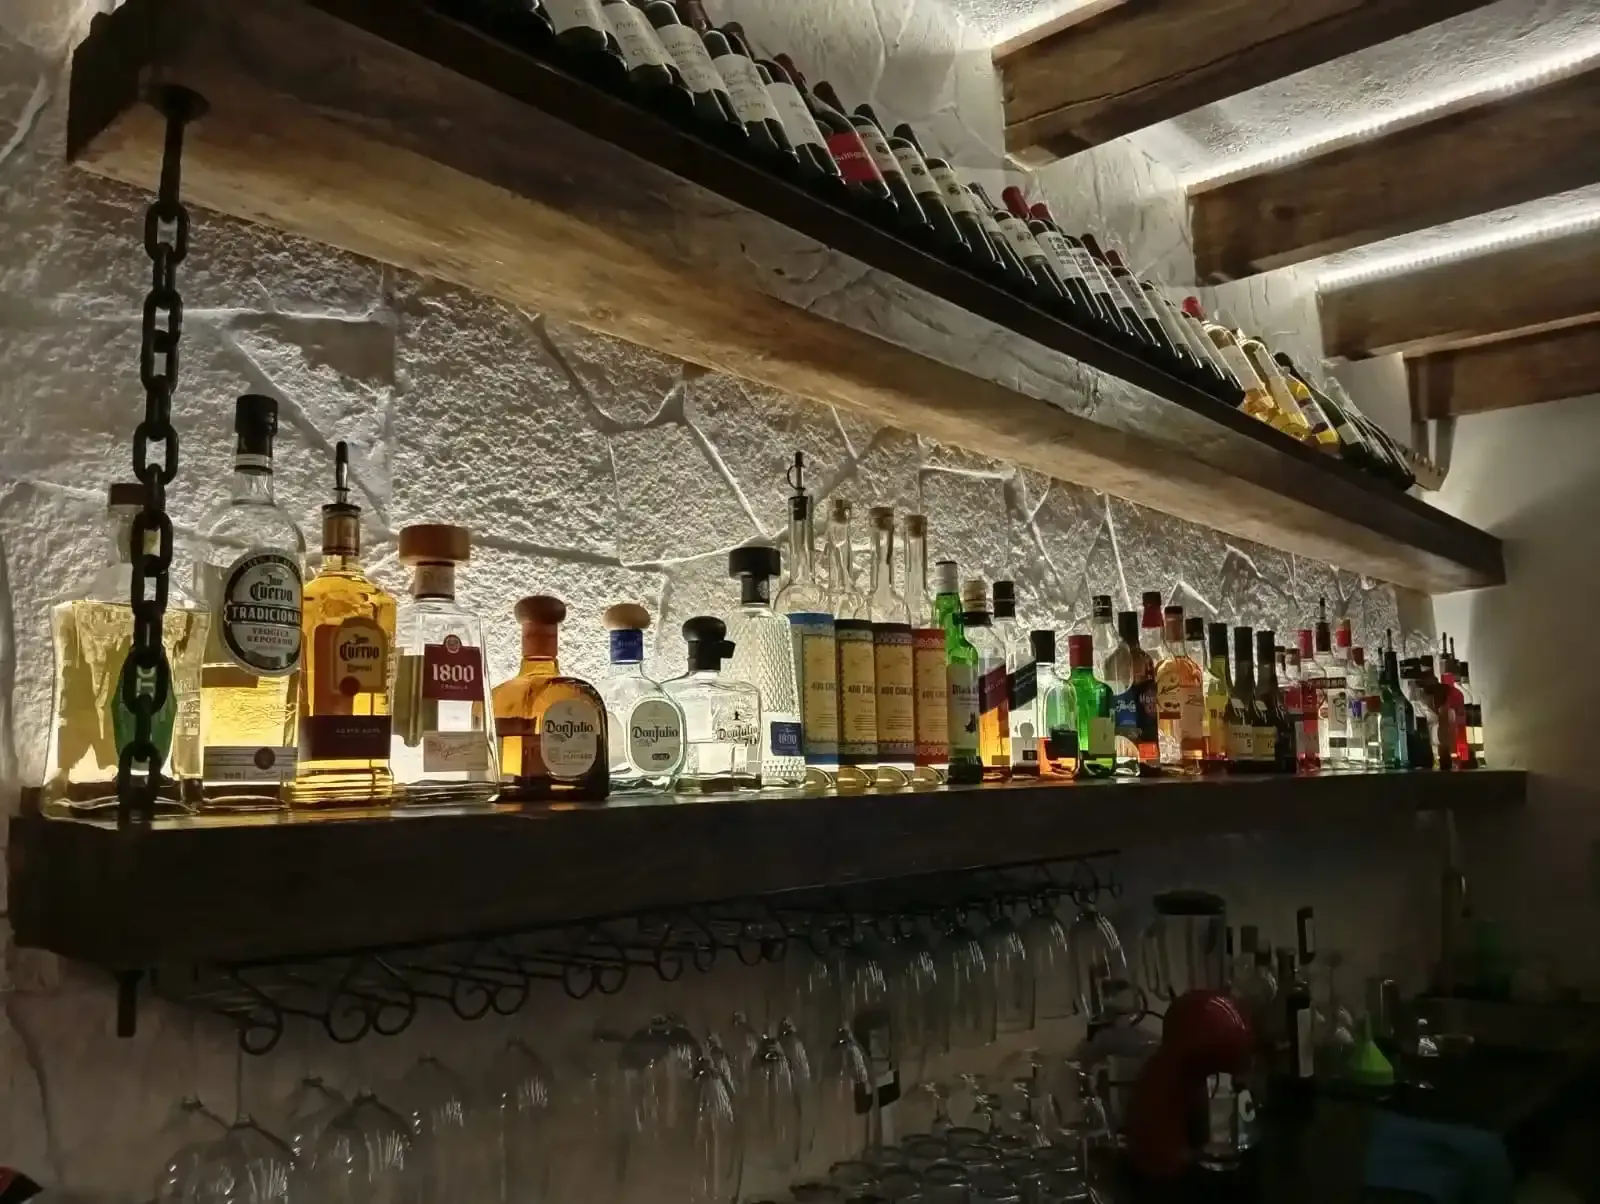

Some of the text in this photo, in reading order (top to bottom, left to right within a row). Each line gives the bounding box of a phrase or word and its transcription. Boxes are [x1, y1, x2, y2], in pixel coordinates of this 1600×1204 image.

[250, 581, 293, 602] Cuervo
[340, 641, 380, 661] Cuervo
[432, 663, 474, 683] 1800
